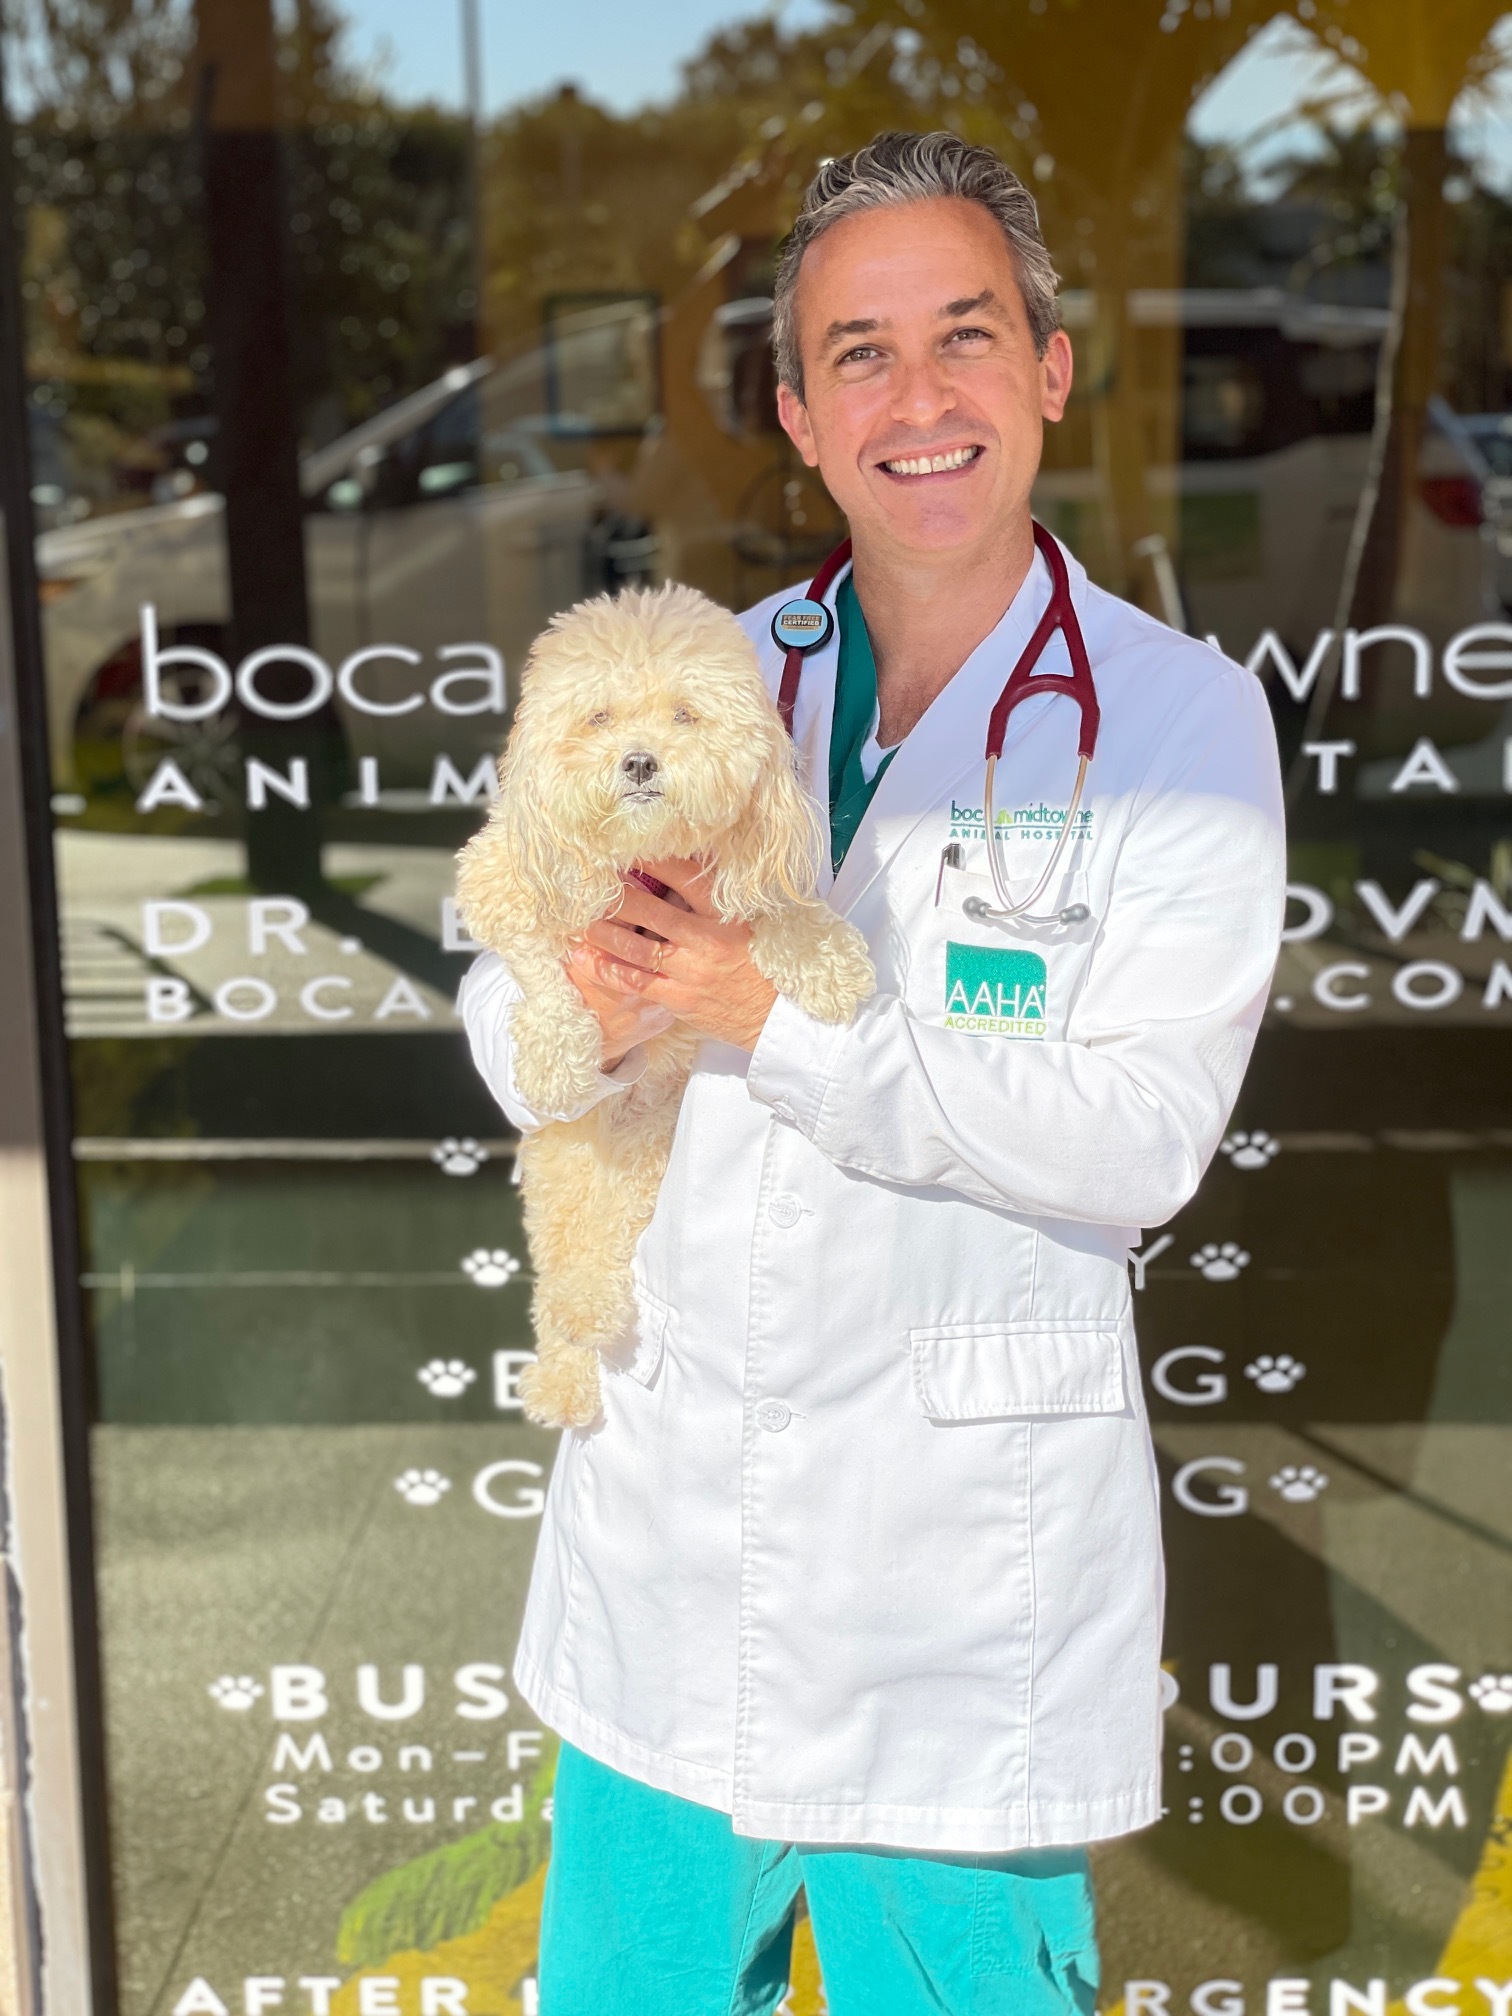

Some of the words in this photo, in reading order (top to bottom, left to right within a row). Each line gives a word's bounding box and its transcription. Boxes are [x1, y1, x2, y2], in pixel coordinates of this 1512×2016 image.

[140, 602, 506, 720] boca
[950, 800, 985, 822] boc
[949, 828, 1011, 840] ANIAL
[1020, 830, 1094, 841] HOSPTAL
[144, 898, 362, 955] DR.
[146, 975, 462, 1023] BOCA
[945, 979, 1045, 1019] AAHA
[944, 1015, 1048, 1035] ACCREDITED
[1160, 1785, 1468, 1828] :00PM
[172, 1976, 469, 2016] AFTER
